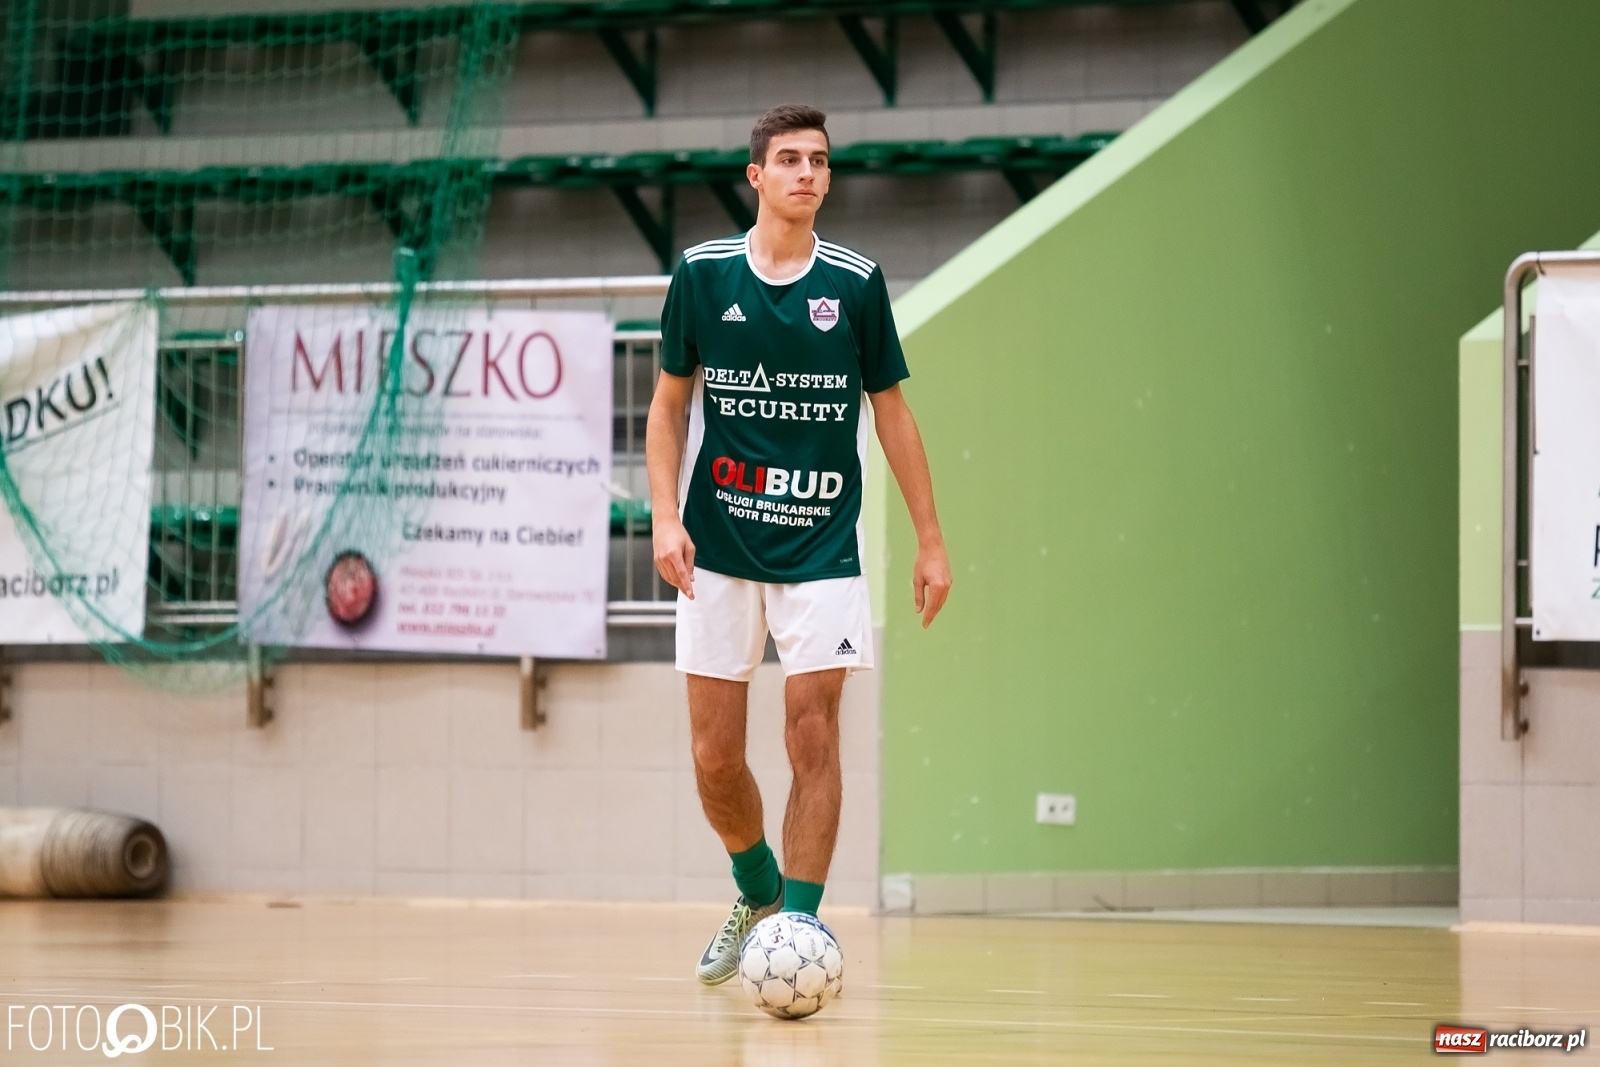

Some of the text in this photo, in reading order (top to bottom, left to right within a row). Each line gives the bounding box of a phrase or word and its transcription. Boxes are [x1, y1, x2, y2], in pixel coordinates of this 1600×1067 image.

[721, 314, 746, 322] adidas
[709, 393, 848, 421] ECURITY
[711, 456, 844, 500] OLIBUD
[715, 488, 831, 517] USŁUGI BRUKARSKIE
[728, 504, 814, 528] PIOTR BADURA
[490, 527, 509, 543] na
[516, 525, 585, 547] Ciebie!
[835, 648, 857, 656] adidas
